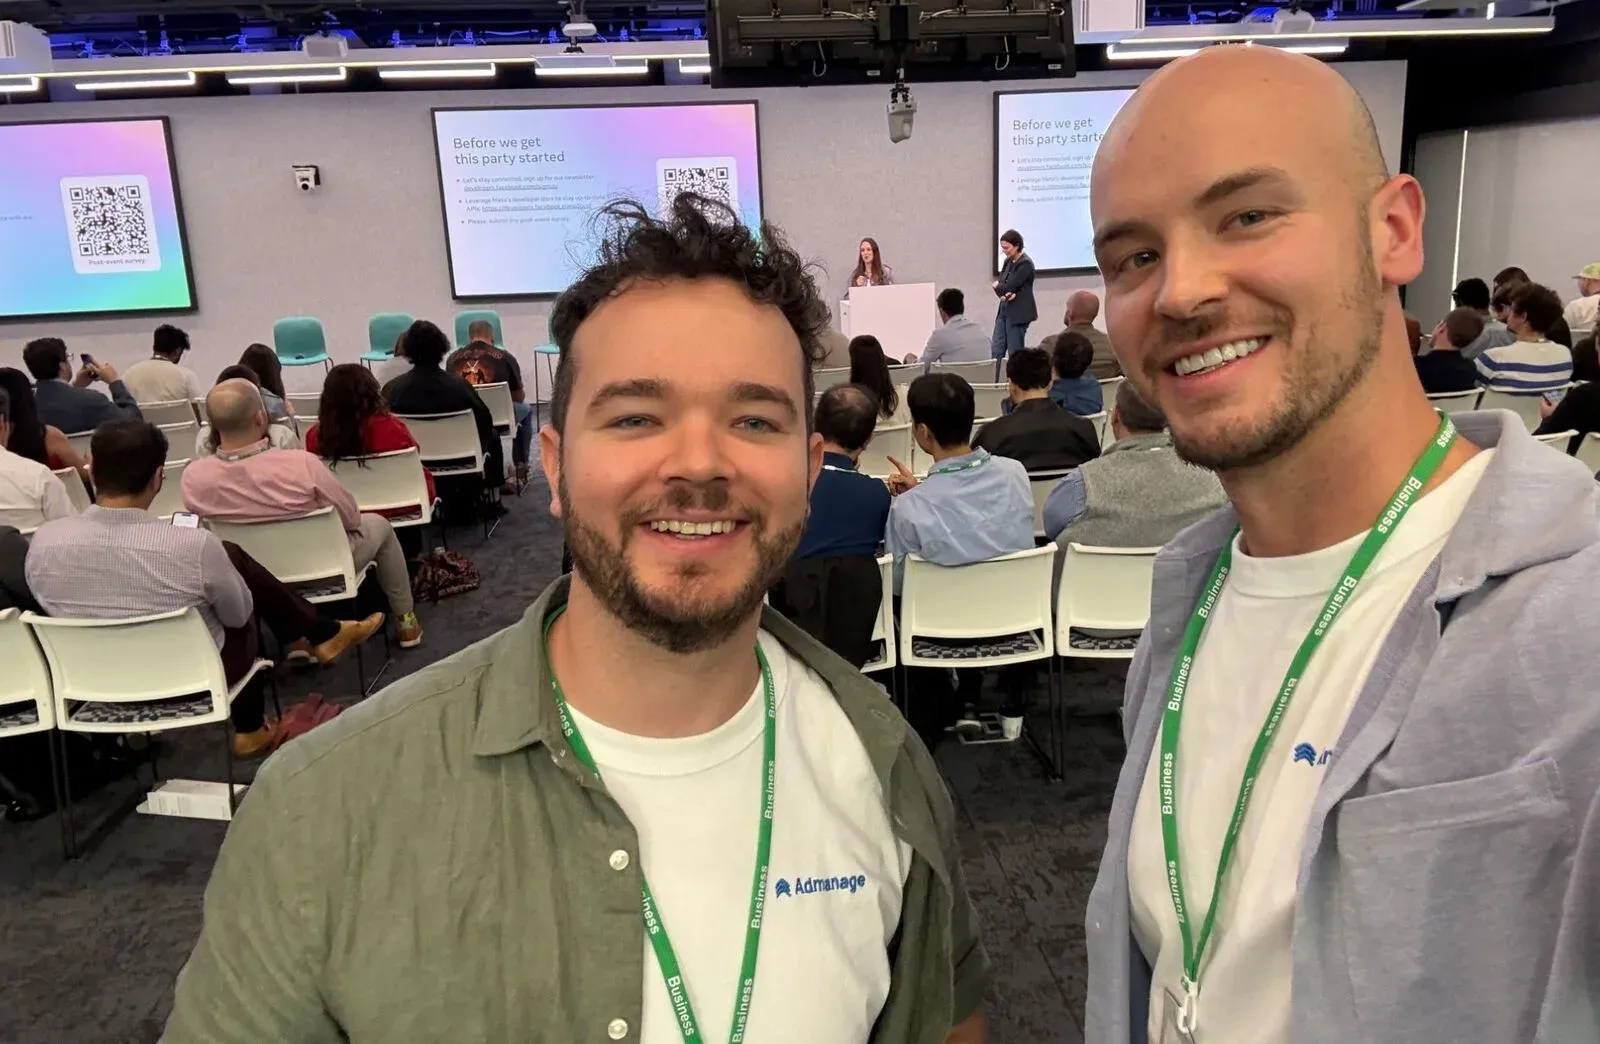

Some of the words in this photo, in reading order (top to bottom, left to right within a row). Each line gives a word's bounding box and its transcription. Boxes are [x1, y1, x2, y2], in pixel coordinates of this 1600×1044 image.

[453, 137, 496, 149] Before
[499, 139, 518, 148] we
[521, 137, 542, 150] get
[1013, 119, 1051, 130] Before
[1055, 120, 1071, 129] we
[1074, 116, 1093, 131] get
[1013, 134, 1034, 146] this
[1037, 133, 1067, 148] party
[455, 153, 479, 165] this
[482, 153, 516, 166] party
[519, 150, 565, 163] started
[1377, 476, 1422, 534] Business
[1198, 566, 1228, 618] Business
[1314, 575, 1358, 637] Business
[1168, 655, 1192, 712] Business
[1264, 677, 1298, 737] Business
[1162, 752, 1173, 815] Business
[751, 864, 768, 929] Business
[795, 875, 866, 894] Admanage
[667, 975, 695, 1036] Business
[732, 978, 753, 1043] Business
